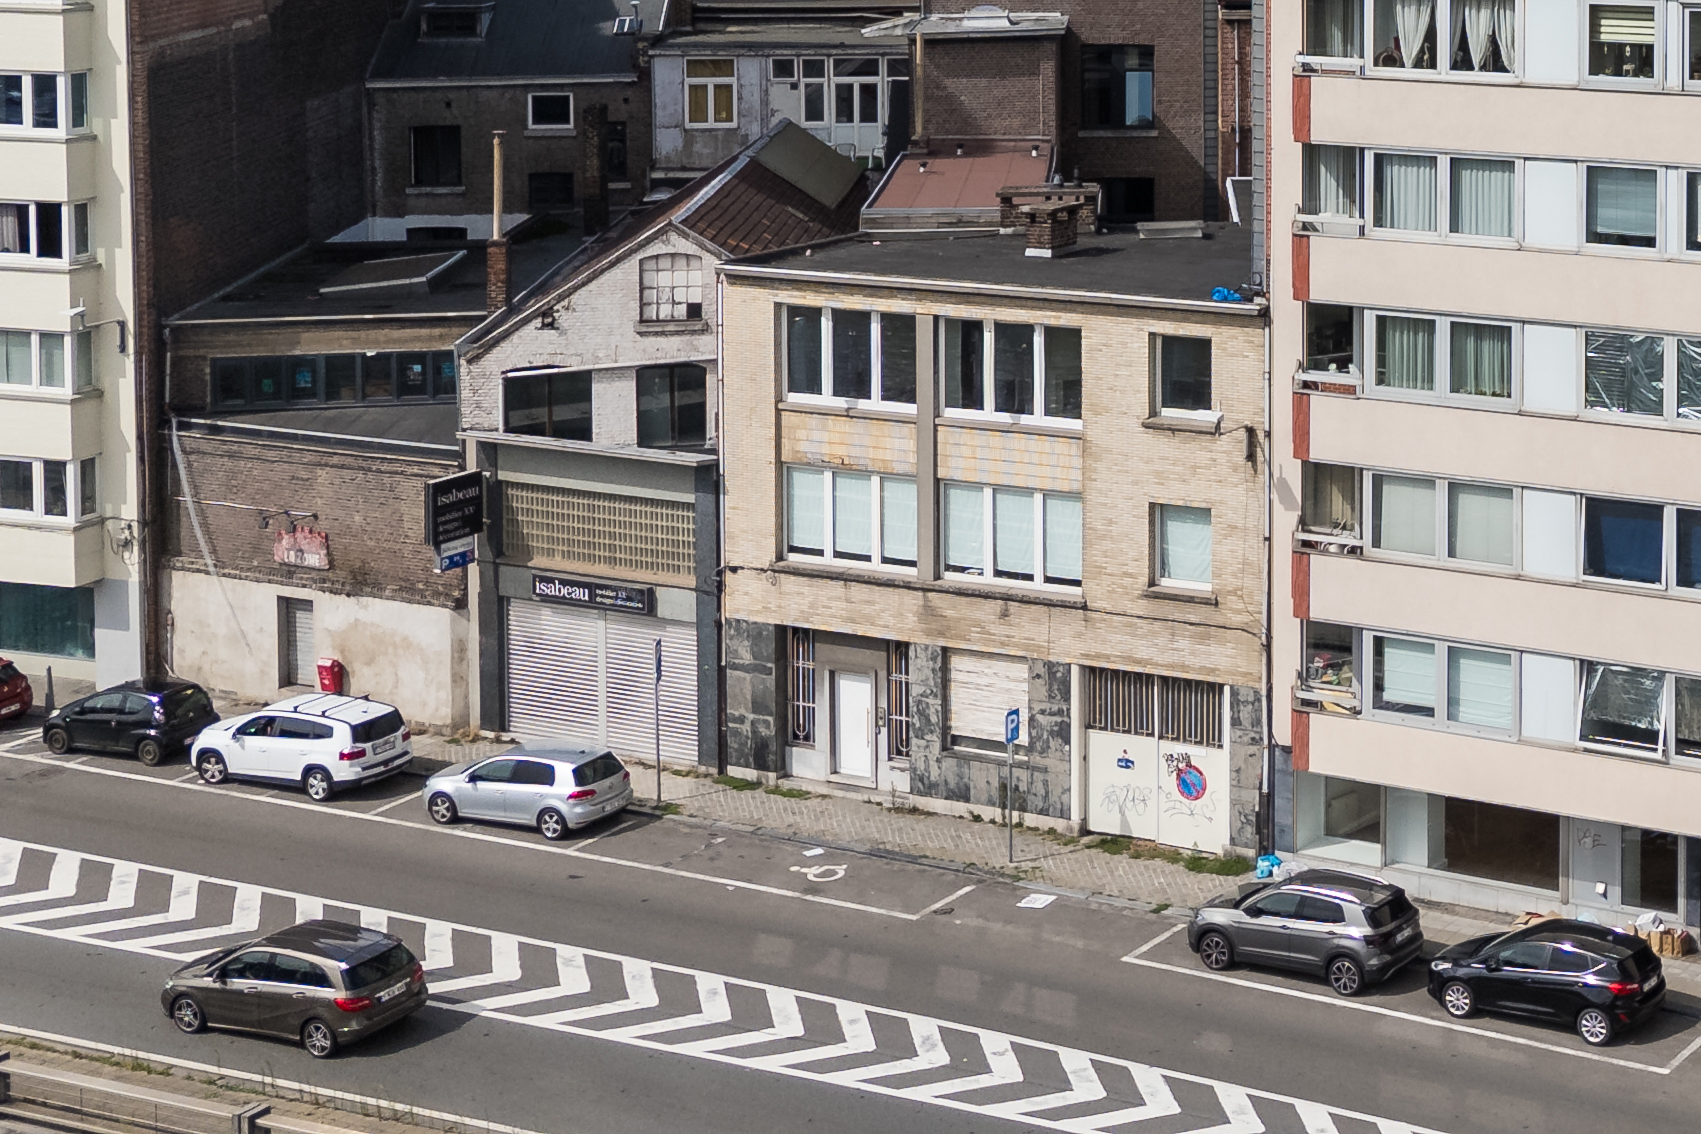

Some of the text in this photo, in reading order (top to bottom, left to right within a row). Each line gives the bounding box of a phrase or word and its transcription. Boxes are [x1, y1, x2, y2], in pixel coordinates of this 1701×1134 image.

[437, 486, 479, 506] isabeau
[535, 577, 589, 601] isabeau
[1007, 714, 1018, 740] P
